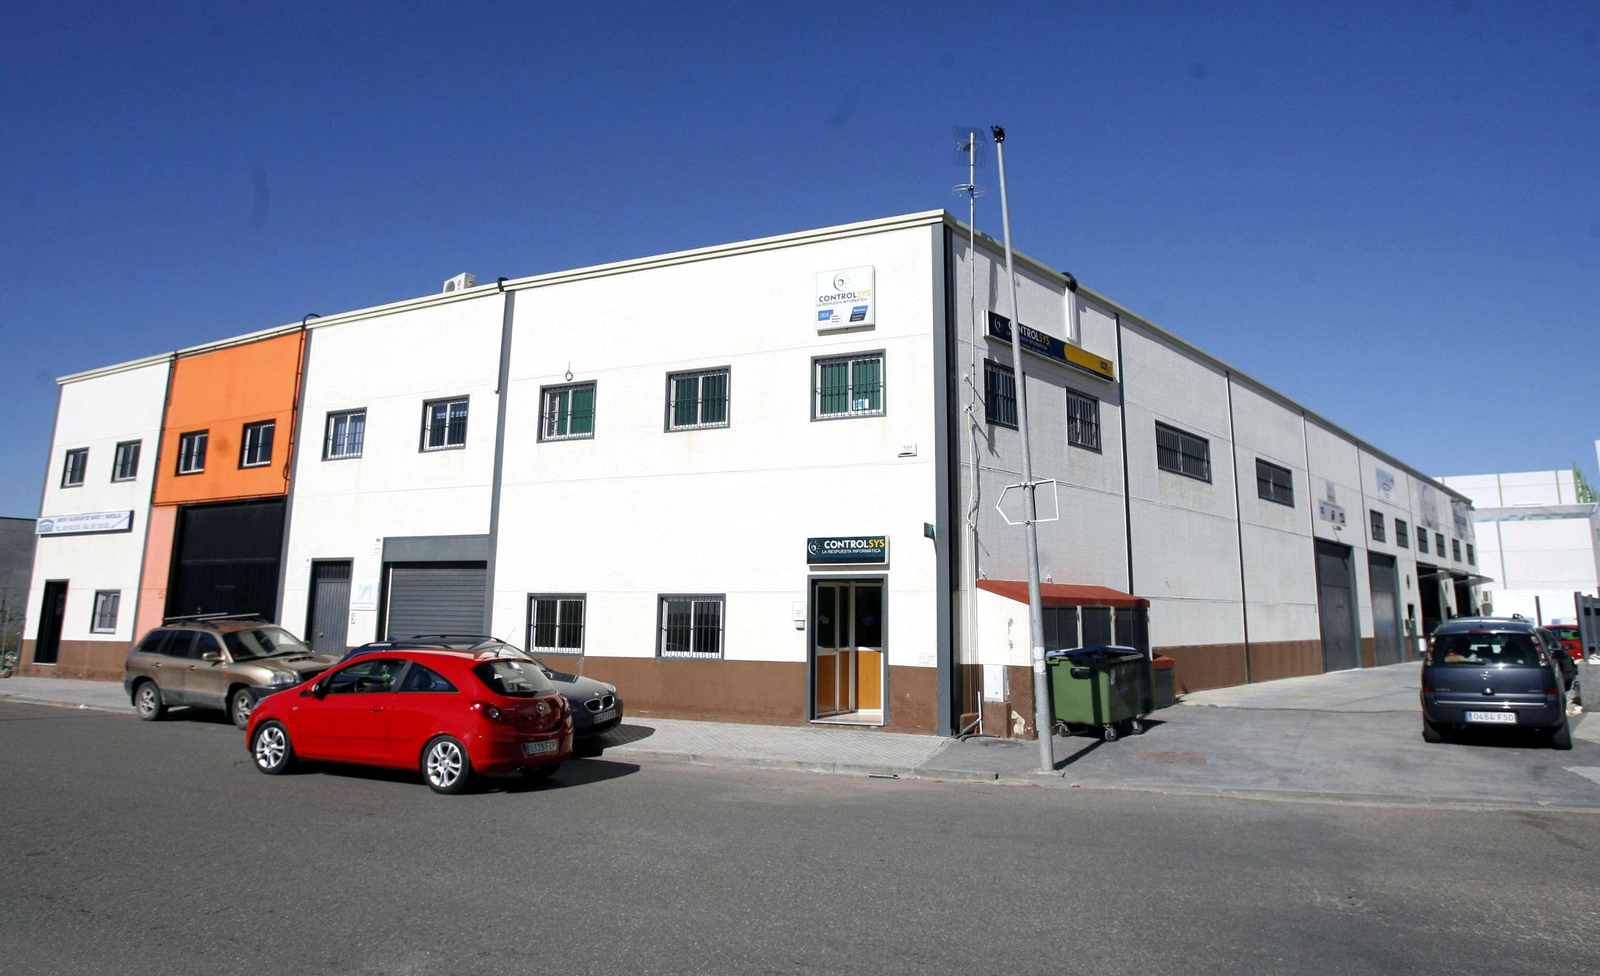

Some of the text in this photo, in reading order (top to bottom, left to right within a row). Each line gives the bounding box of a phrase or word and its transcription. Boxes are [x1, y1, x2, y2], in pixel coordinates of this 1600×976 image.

[819, 290, 871, 302] CONTROLSYS
[1008, 321, 1050, 345] CNTROLSYS
[824, 539, 885, 549] CONTROLSYS
[1497, 713, 1514, 721] FSD
